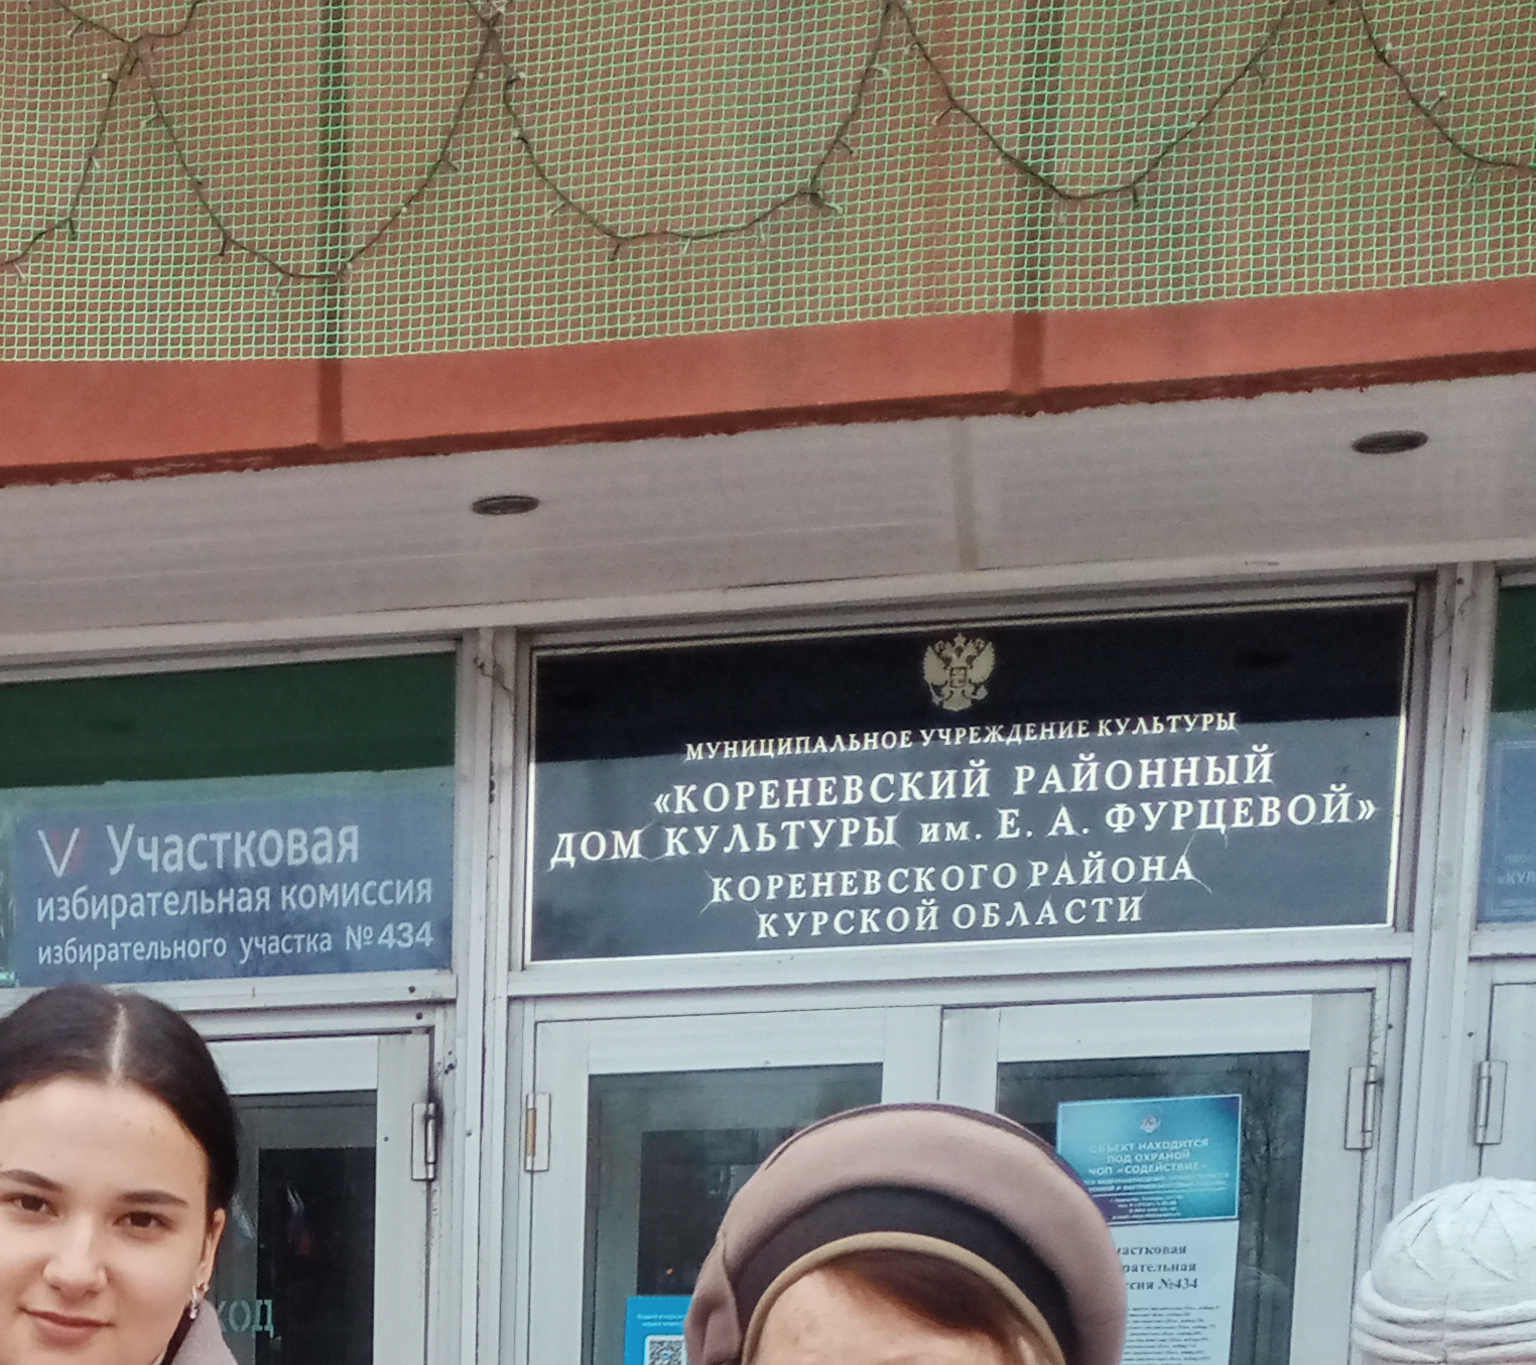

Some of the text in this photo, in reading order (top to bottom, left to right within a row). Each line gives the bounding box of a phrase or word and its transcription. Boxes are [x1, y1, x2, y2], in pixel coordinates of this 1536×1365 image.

[685, 711, 1238, 761] МУНИЦИПАЛЬНОЕ УЧРЕЖДЕНИЕ КУЛЬТУРЫ
[653, 747, 1275, 815] «КОРЕНЕВСКИЙ РАЙОННЫЙ
[106, 823, 360, 876] Участковая
[549, 785, 1378, 872] ДОМ КУЛЬТУРЫ им. Е. А. ФУРЦЕВОЙ»
[710, 854, 1195, 904] КОРЕНЕВСКОГО РАЙОНА
[36, 877, 433, 930] избирательная комиссия
[757, 894, 1144, 939] КУРСКОЙ ОБЛАСТИ
[38, 934, 227, 971] избирательного
[239, 929, 333, 966] участка
[1107, 1149, 1191, 1164] ПОД ОХРАНОЙ
[1138, 1138, 1209, 1151] НАХОДИТСЯ
[1117, 1245, 1187, 1256] астковая
[1122, 1262, 1197, 1273] рательная
